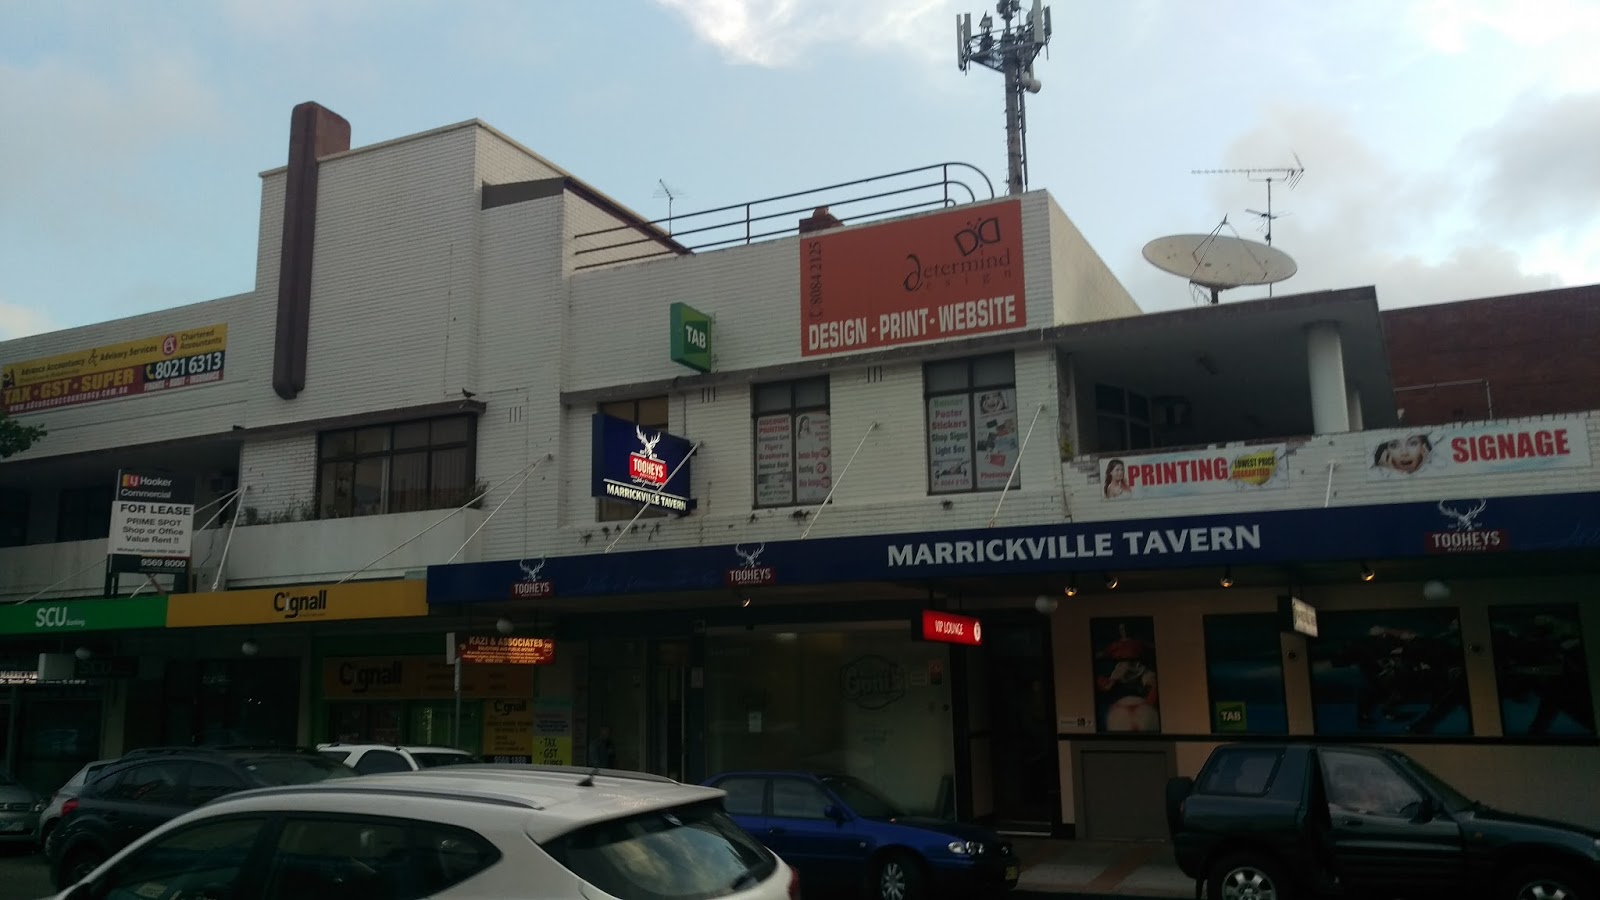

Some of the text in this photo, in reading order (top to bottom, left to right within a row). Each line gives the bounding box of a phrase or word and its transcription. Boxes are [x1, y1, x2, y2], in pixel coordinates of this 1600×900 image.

[809, 241, 822, 271] 2125
[903, 248, 1011, 292] determind
[809, 295, 1017, 351] DESIGN PRINT WEBSITE
[180, 336, 223, 350] Accountants
[181, 329, 214, 342] Chartered
[685, 325, 706, 349] TAB
[21, 345, 157, 376] Advance Accountancy & Advisory Services
[155, 352, 222, 379] 8021 6313
[4, 386, 32, 405] TAX
[41, 379, 71, 399] GST
[81, 368, 134, 392] SUPER
[935, 410, 962, 418] Poster
[931, 421, 967, 430] Stickers
[935, 446, 951, 456] Light
[1450, 429, 1571, 464] SIGNAGE
[633, 457, 664, 478] TOOHEYS
[1234, 456, 1275, 469] LOWEST PRICE
[1127, 457, 1228, 487] PRINTING
[140, 476, 172, 487] Hooker
[121, 488, 171, 498] Commercial
[606, 483, 687, 511] MARRICKVILLE TAVERN
[120, 504, 191, 516] FOR LEASE
[127, 518, 155, 526] PRIME
[123, 526, 145, 534] Shop
[888, 524, 1262, 567] MARRICKVILLE TAVERN
[1432, 531, 1501, 548] TOOHEYS
[141, 559, 162, 567] 9569
[729, 568, 771, 582] TOOHEYS
[513, 582, 550, 595] TOOHEYS
[274, 590, 327, 618] Cignall
[35, 606, 68, 628] SCU
[935, 620, 943, 632] VIP
[944, 621, 963, 636] LOUNGE
[468, 636, 488, 645] KAZI
[489, 637, 496, 646] &
[497, 637, 543, 648] ASSOCIATES
[340, 661, 401, 692] Cignall
[494, 699, 527, 716] Cignall
[1220, 710, 1242, 722] TAB
[544, 738, 556, 748] TAX
[544, 749, 558, 759] GST
